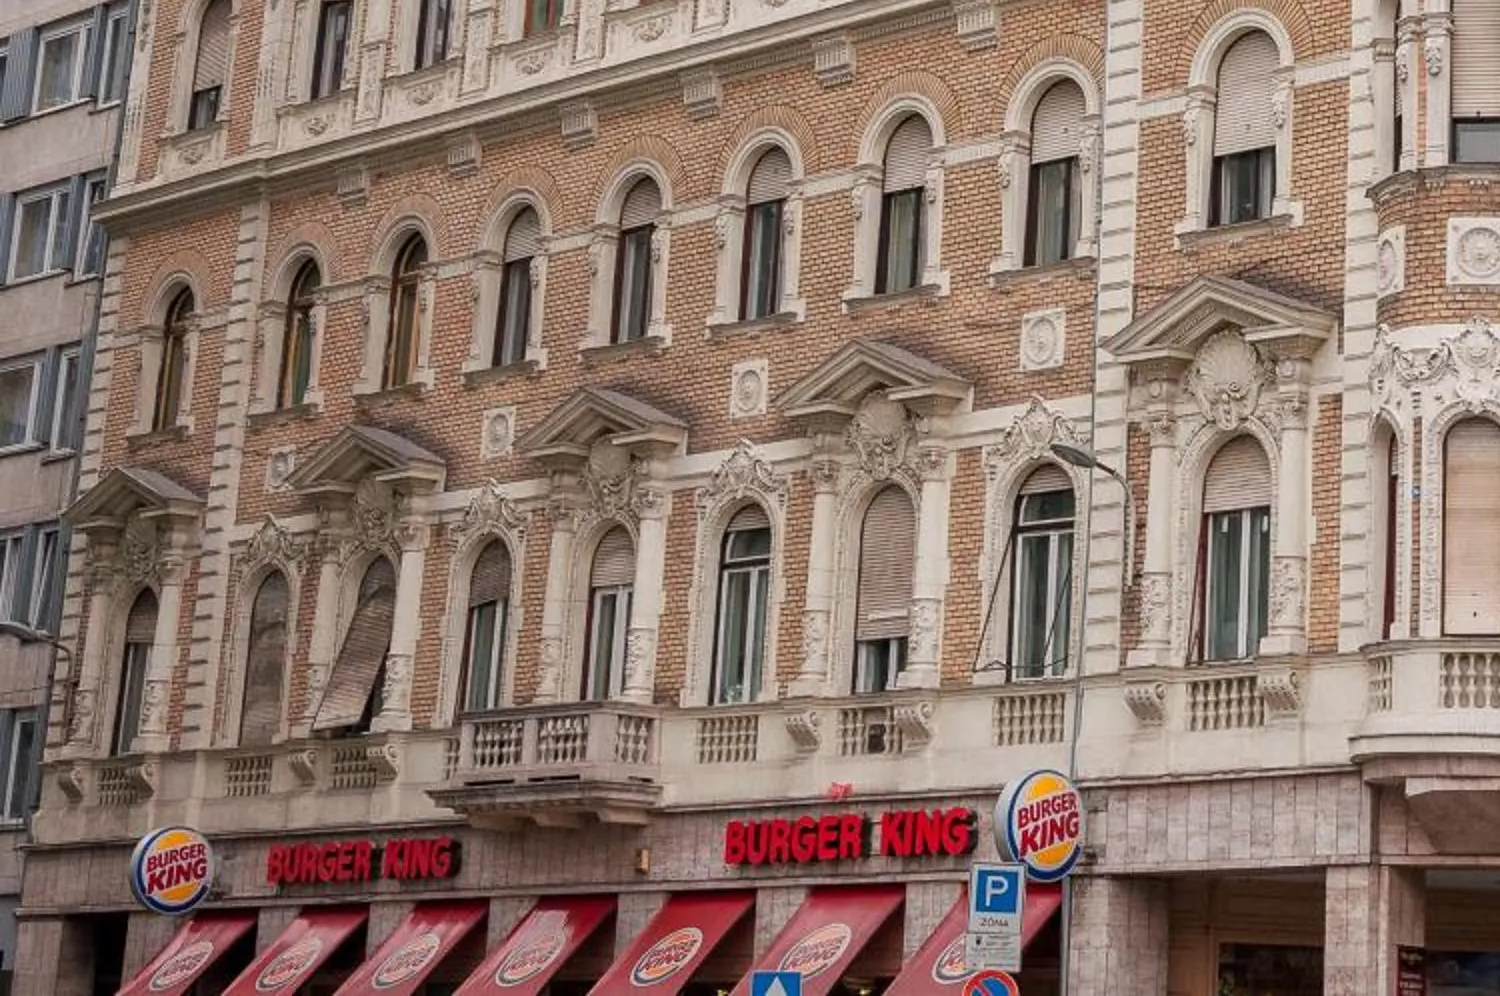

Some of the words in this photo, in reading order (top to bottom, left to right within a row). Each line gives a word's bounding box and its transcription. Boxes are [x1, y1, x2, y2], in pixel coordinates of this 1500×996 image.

[1018, 792, 1077, 829] BURGER
[725, 814, 863, 866] BURGER
[880, 806, 971, 857] KING
[1020, 812, 1079, 858] KING
[146, 858, 207, 894] KING
[147, 844, 206, 872] BURGER
[267, 839, 372, 887] BURGER
[382, 835, 451, 879] KING
[986, 875, 1009, 907] P
